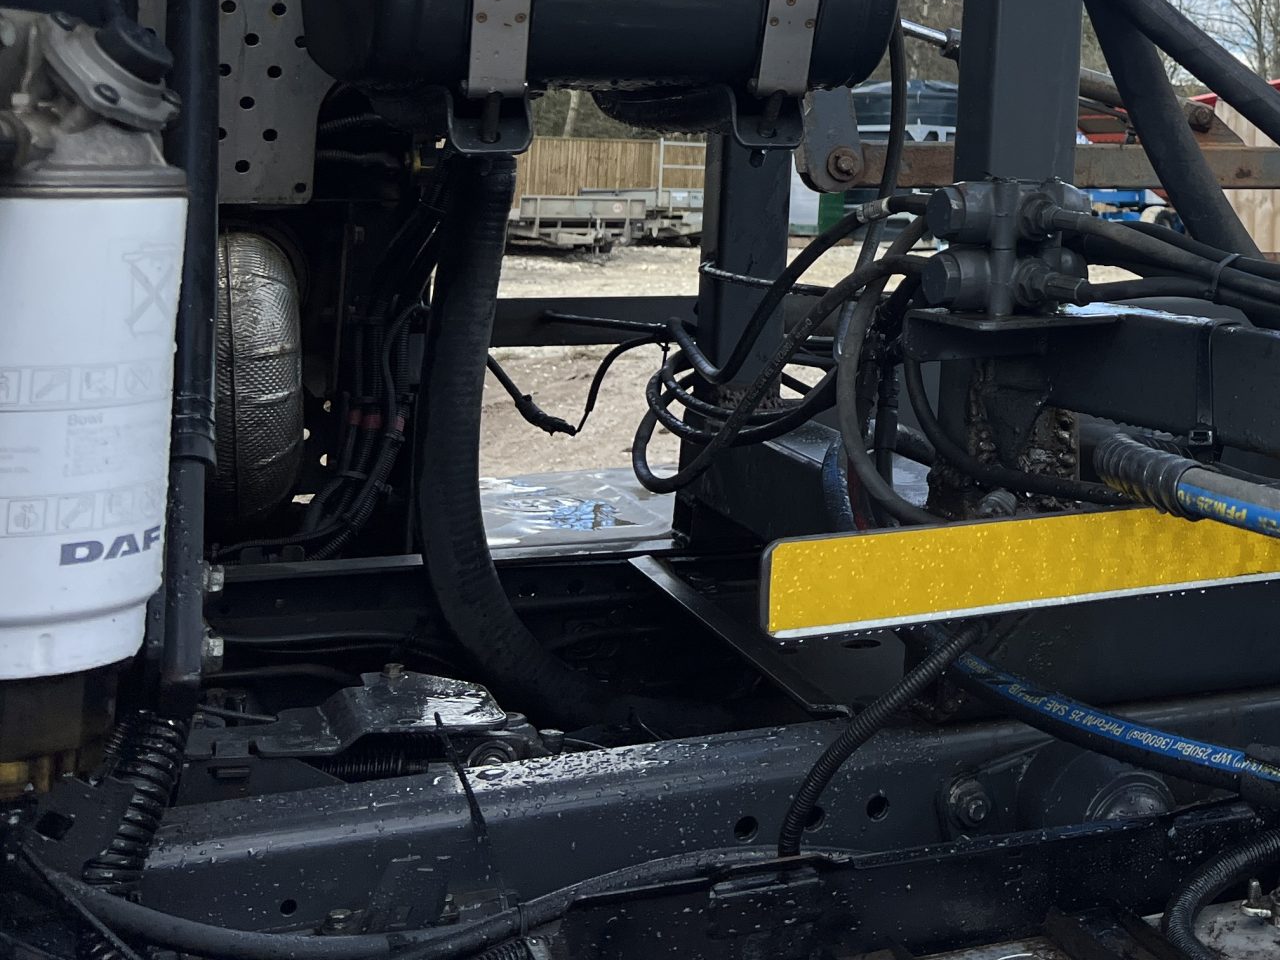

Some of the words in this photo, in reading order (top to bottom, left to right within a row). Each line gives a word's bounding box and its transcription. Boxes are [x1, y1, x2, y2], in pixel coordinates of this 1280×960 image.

[59, 525, 161, 566] DAF
[1044, 700, 1069, 716] SAE
[1211, 752, 1233, 767] WP
